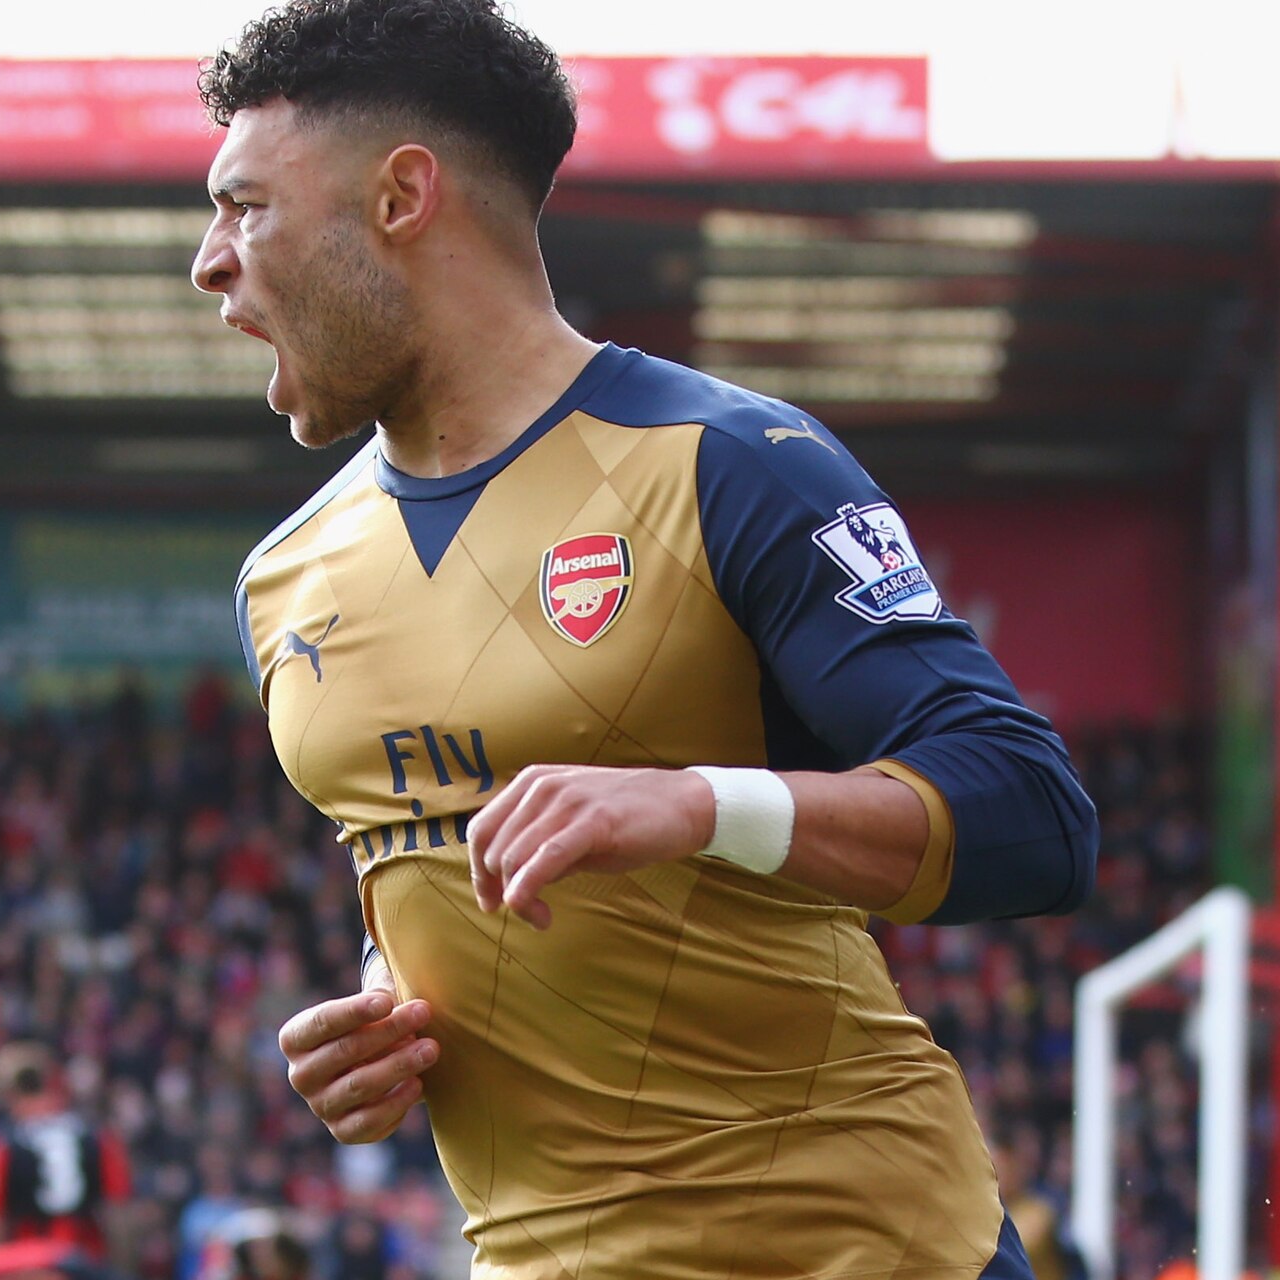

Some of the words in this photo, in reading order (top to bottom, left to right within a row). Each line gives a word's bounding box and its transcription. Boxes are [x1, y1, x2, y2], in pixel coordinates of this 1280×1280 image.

[551, 547, 619, 576] Arsenal
[877, 587, 912, 610] PREMIER
[381, 725, 494, 794] Fly
